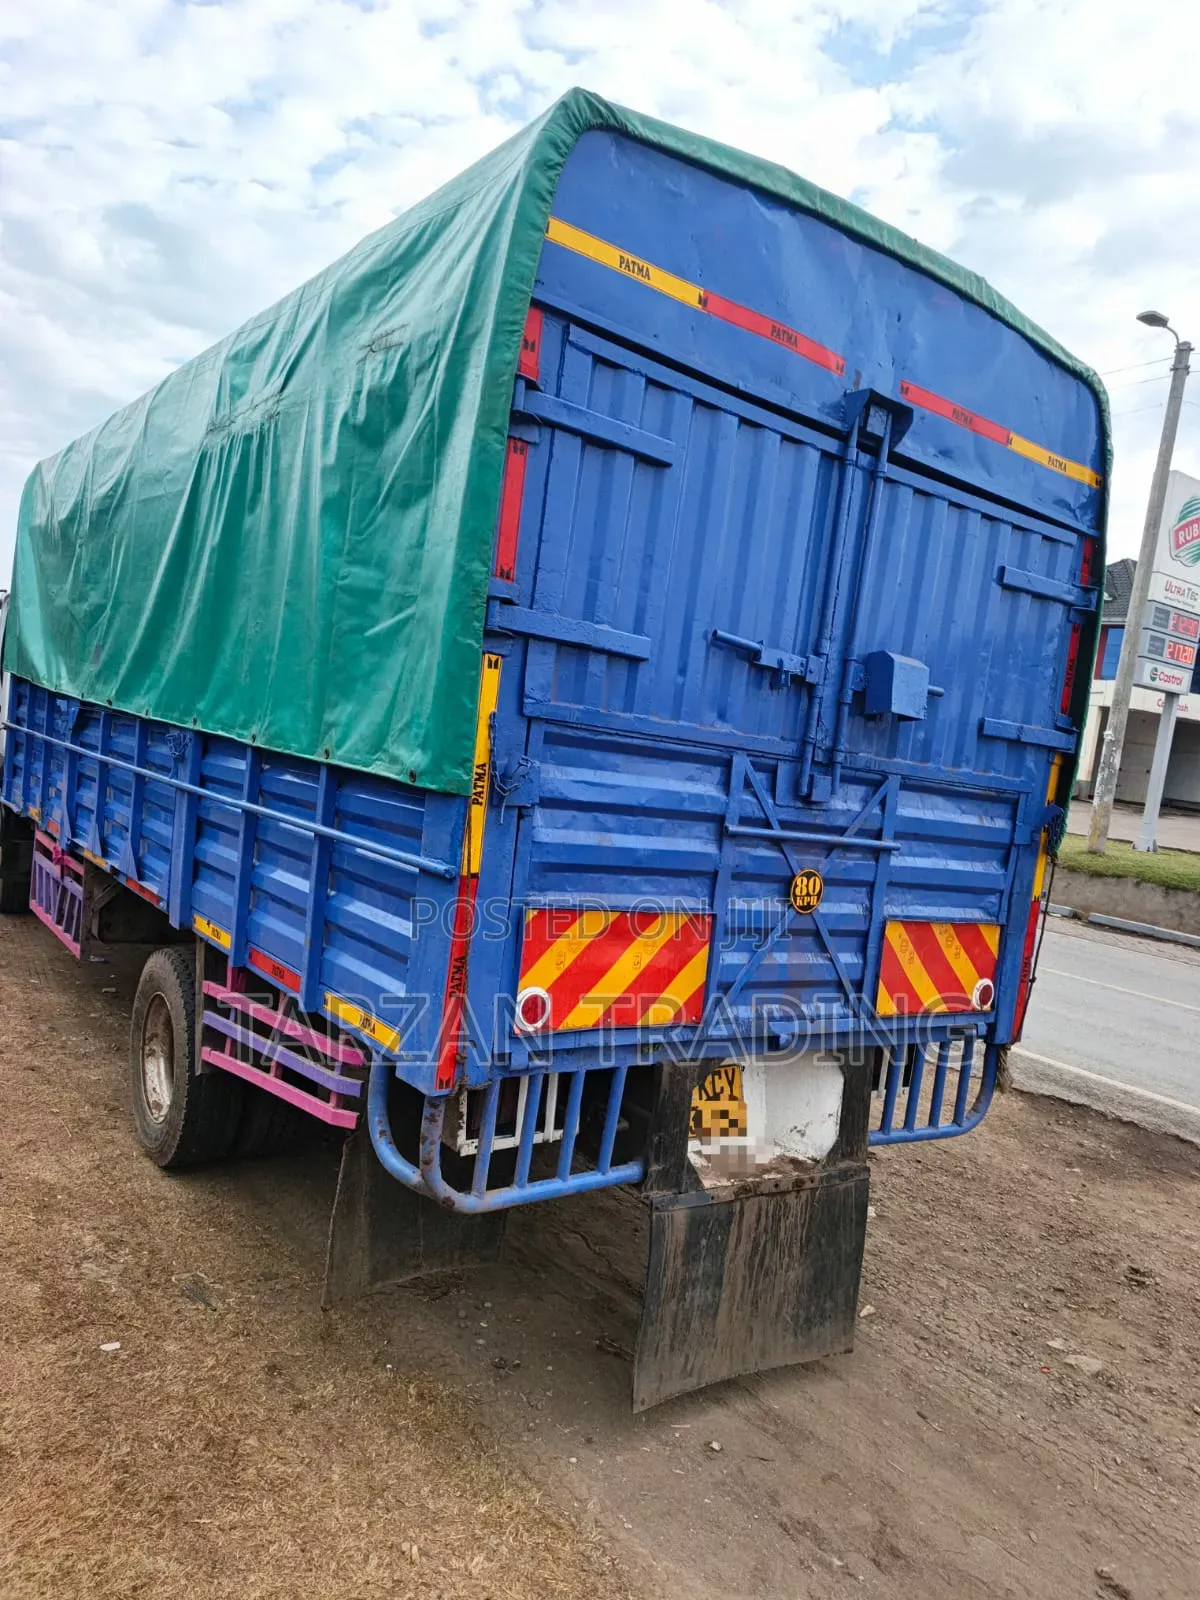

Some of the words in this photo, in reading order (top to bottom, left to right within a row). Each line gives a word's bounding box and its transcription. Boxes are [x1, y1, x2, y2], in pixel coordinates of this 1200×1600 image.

[618, 254, 651, 281] PATMA
[770, 324, 799, 349] PATMA
[951, 407, 973, 426] PATMA
[1047, 455, 1068, 473] PATMA
[1178, 523, 1200, 545] RUB
[1159, 671, 1183, 687] Castrol
[472, 762, 487, 806] PATMA
[795, 876, 820, 896] 80
[796, 896, 818, 906] KPH
[450, 955, 467, 998] PATMA
